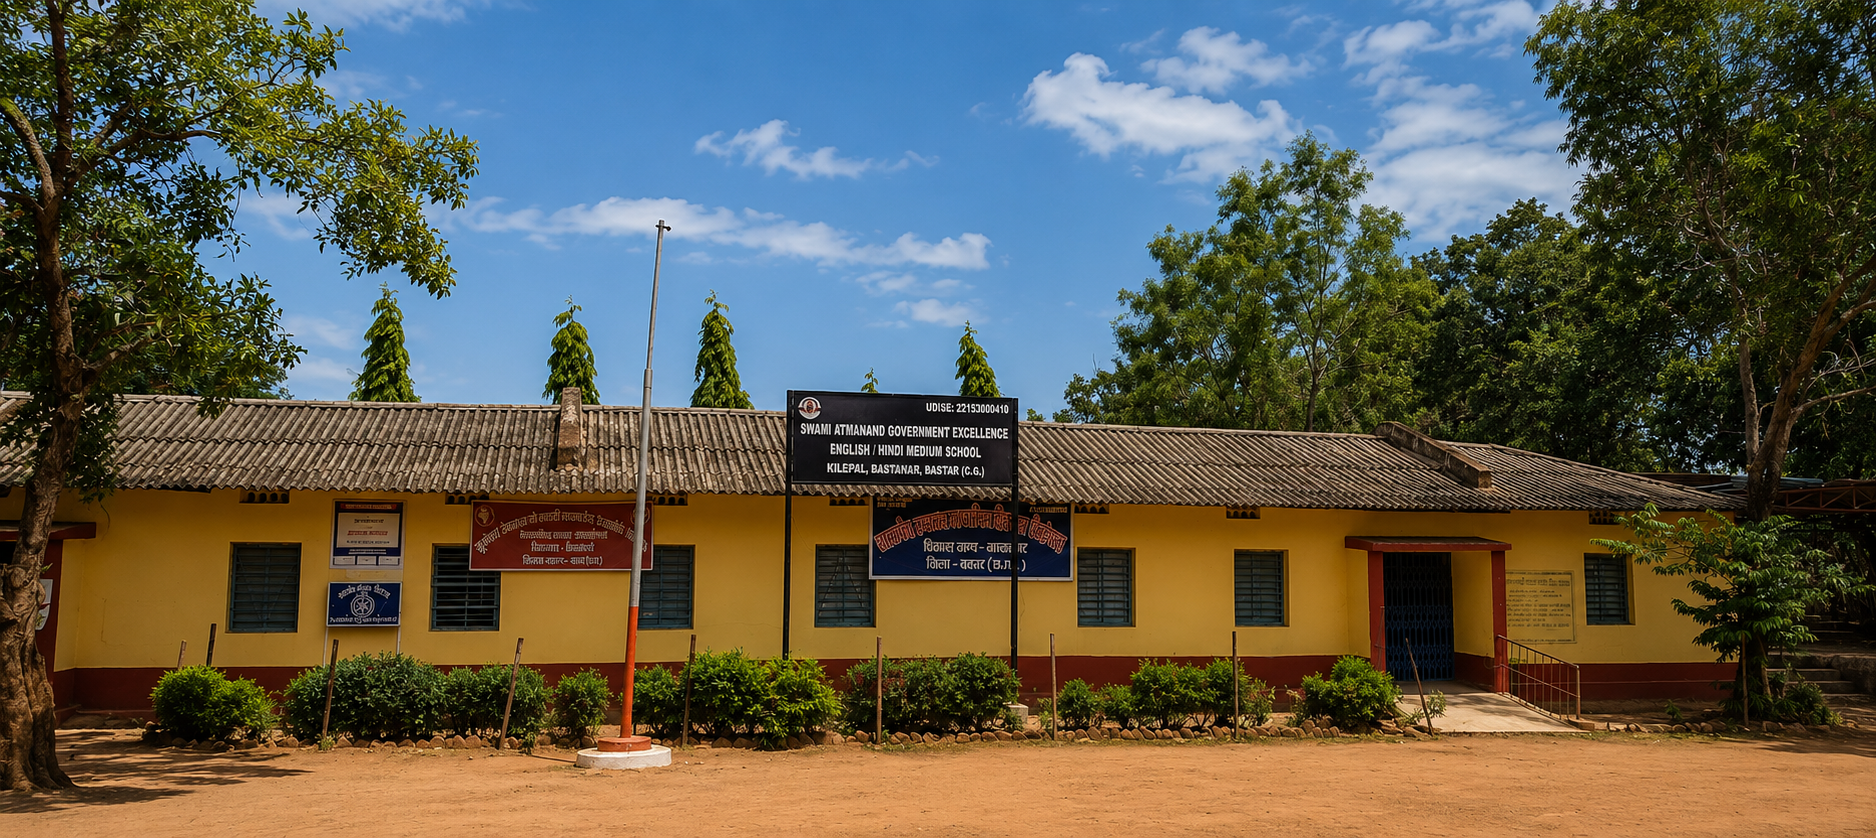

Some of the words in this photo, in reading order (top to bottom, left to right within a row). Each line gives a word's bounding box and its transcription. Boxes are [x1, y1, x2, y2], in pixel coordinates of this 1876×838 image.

[926, 403, 954, 412] UDISE:
[956, 404, 1009, 414] 22153000410
[800, 423, 832, 436] SWAMI
[834, 424, 886, 437] ATMANAND
[888, 425, 950, 439] GOVERNMENT
[952, 427, 1009, 440] EXCELLENCE
[830, 443, 870, 456] ENGLISH
[872, 444, 876, 456] /
[878, 445, 904, 457] HINDI
[906, 445, 943, 457] MEDIUM
[945, 446, 982, 459] SCHOOL
[826, 463, 869, 475] KILEPAL,
[871, 464, 923, 476] BASTANAR,
[924, 465, 960, 476] BASTAR
[961, 466, 985, 479] (C.G.)
